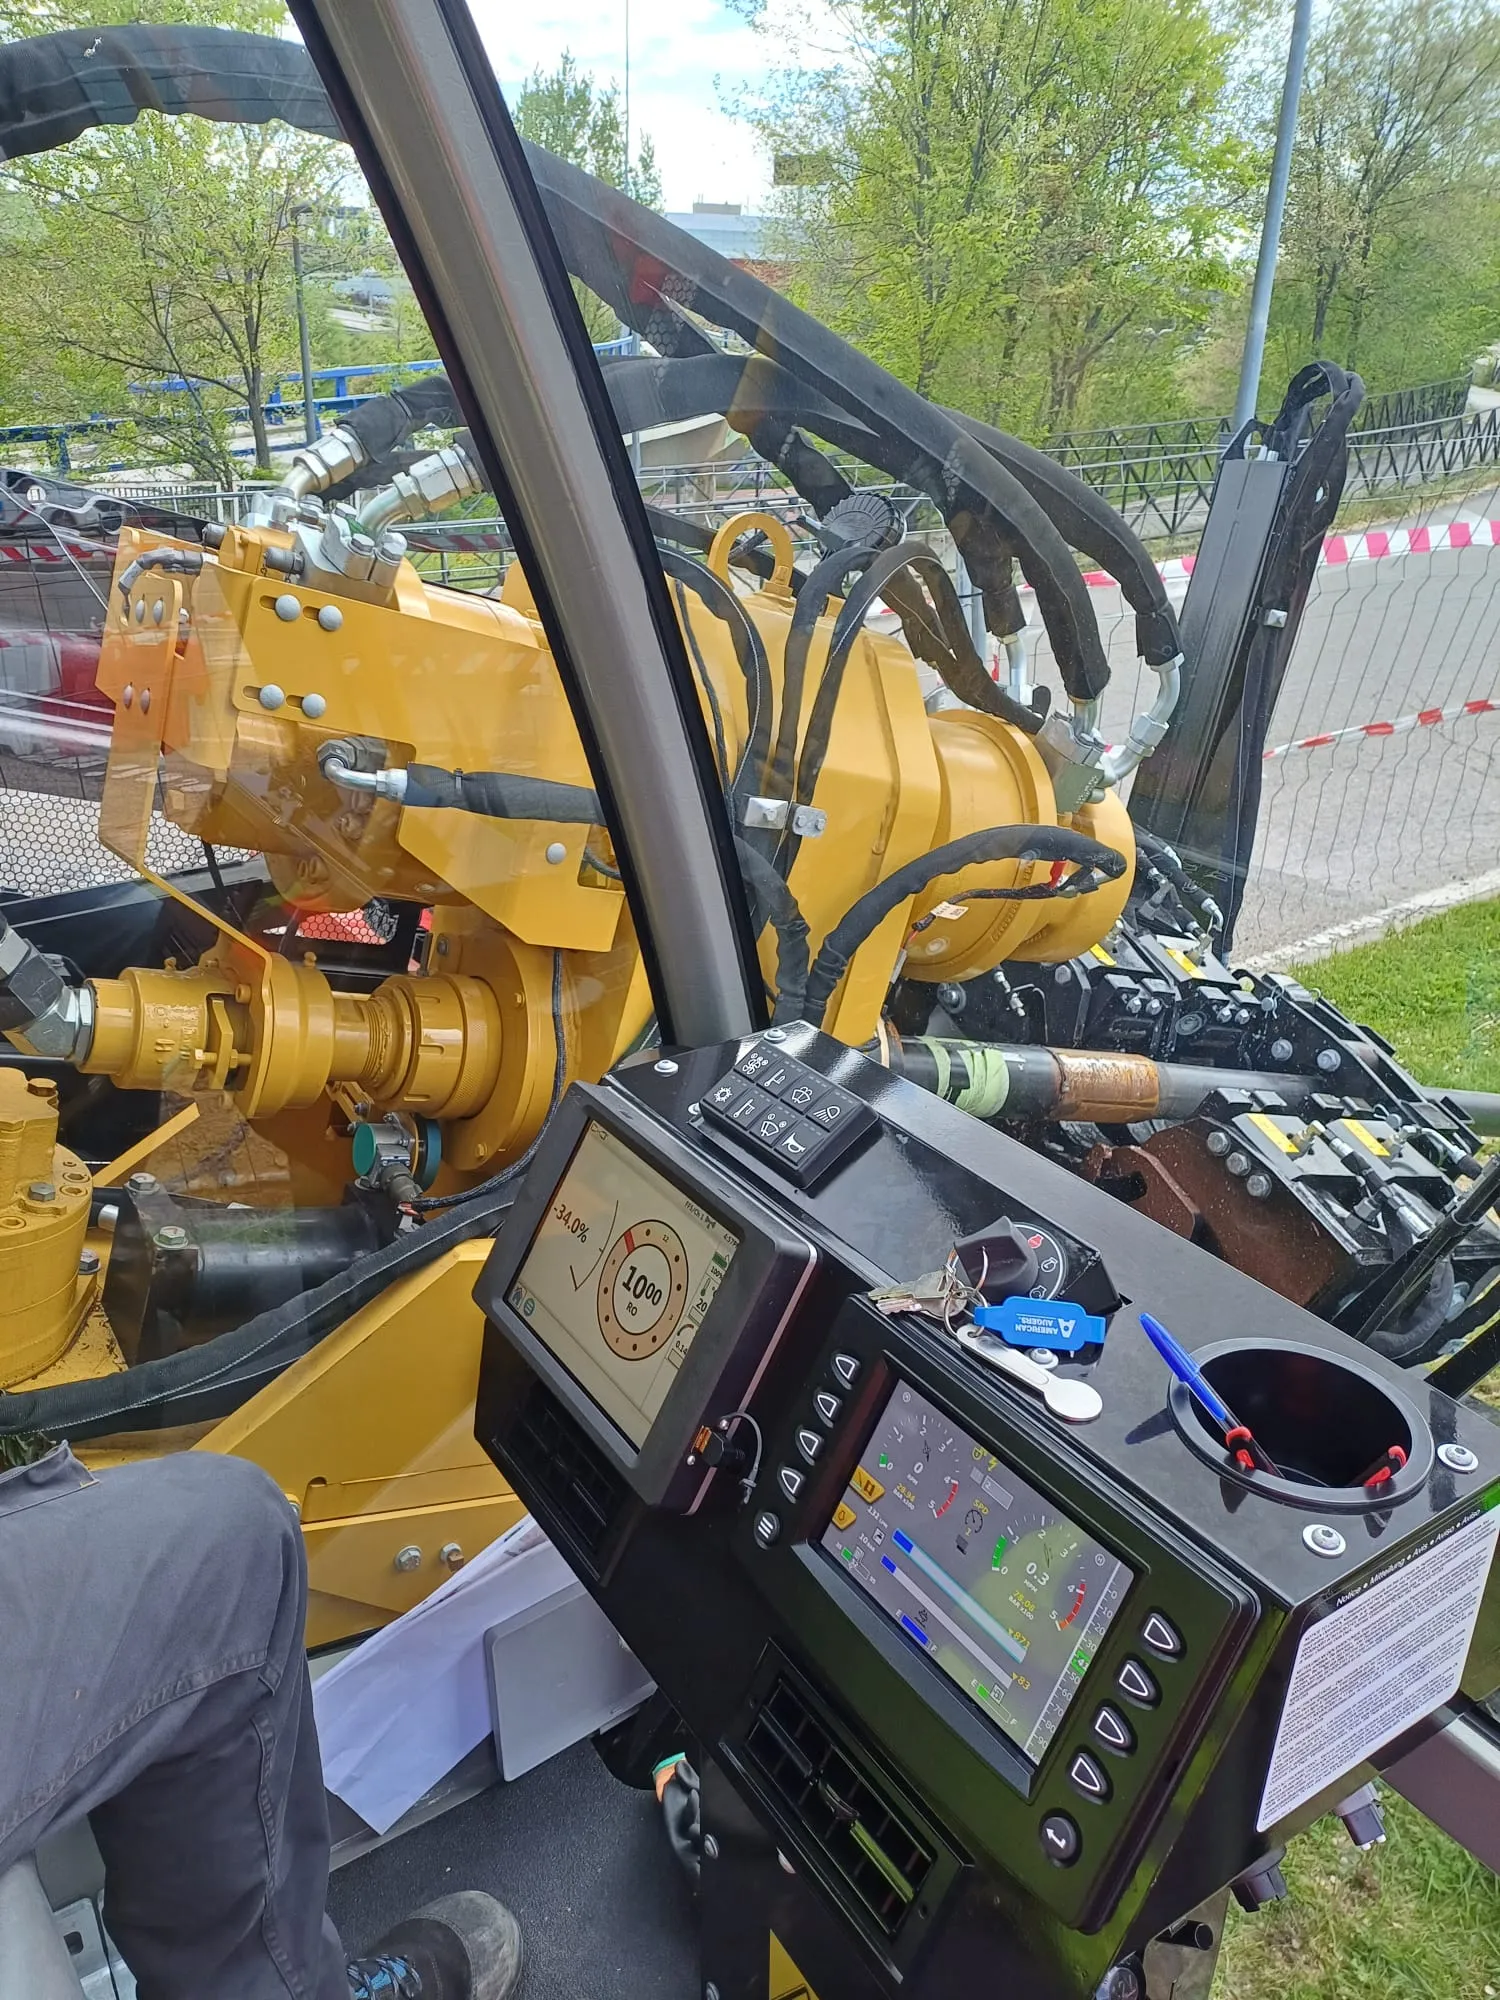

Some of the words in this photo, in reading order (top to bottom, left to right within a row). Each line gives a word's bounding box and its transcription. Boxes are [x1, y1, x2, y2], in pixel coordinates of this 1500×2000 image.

[554, 1204, 589, 1243] -34.0%
[724, 1233, 738, 1248] 4:57P
[622, 1265, 663, 1306] 1000
[626, 1301, 638, 1317] RO
[696, 1298, 707, 1312] 20
[1015, 1324, 1058, 1335] AMERICAN
[887, 1462, 893, 1470] 0
[914, 1462, 923, 1474] 0
[973, 1500, 989, 1515] SPD
[1038, 1529, 1046, 1539] 2
[1060, 1548, 1068, 1558] 3
[1001, 1566, 1008, 1575] 0
[1336, 1587, 1362, 1606] Notice
[1412, 1543, 1429, 1558] Avis
[1435, 1525, 1455, 1543] Aviso
[1026, 1562, 1050, 1586] 0.3
[1110, 1591, 1118, 1599] 0
[1049, 1610, 1058, 1620] 5
[1102, 1606, 1113, 1618] 10
[1094, 1624, 1105, 1636] 20
[1013, 1631, 1031, 1650] 871
[1086, 1641, 1097, 1652] 30
[1017, 1676, 1031, 1690] 83
[1070, 1671, 1081, 1685] 50
[1061, 1688, 1073, 1701] 60
[1053, 1703, 1064, 1717] 70
[1045, 1721, 1056, 1734] 80
[1038, 1736, 1048, 1749] 90
